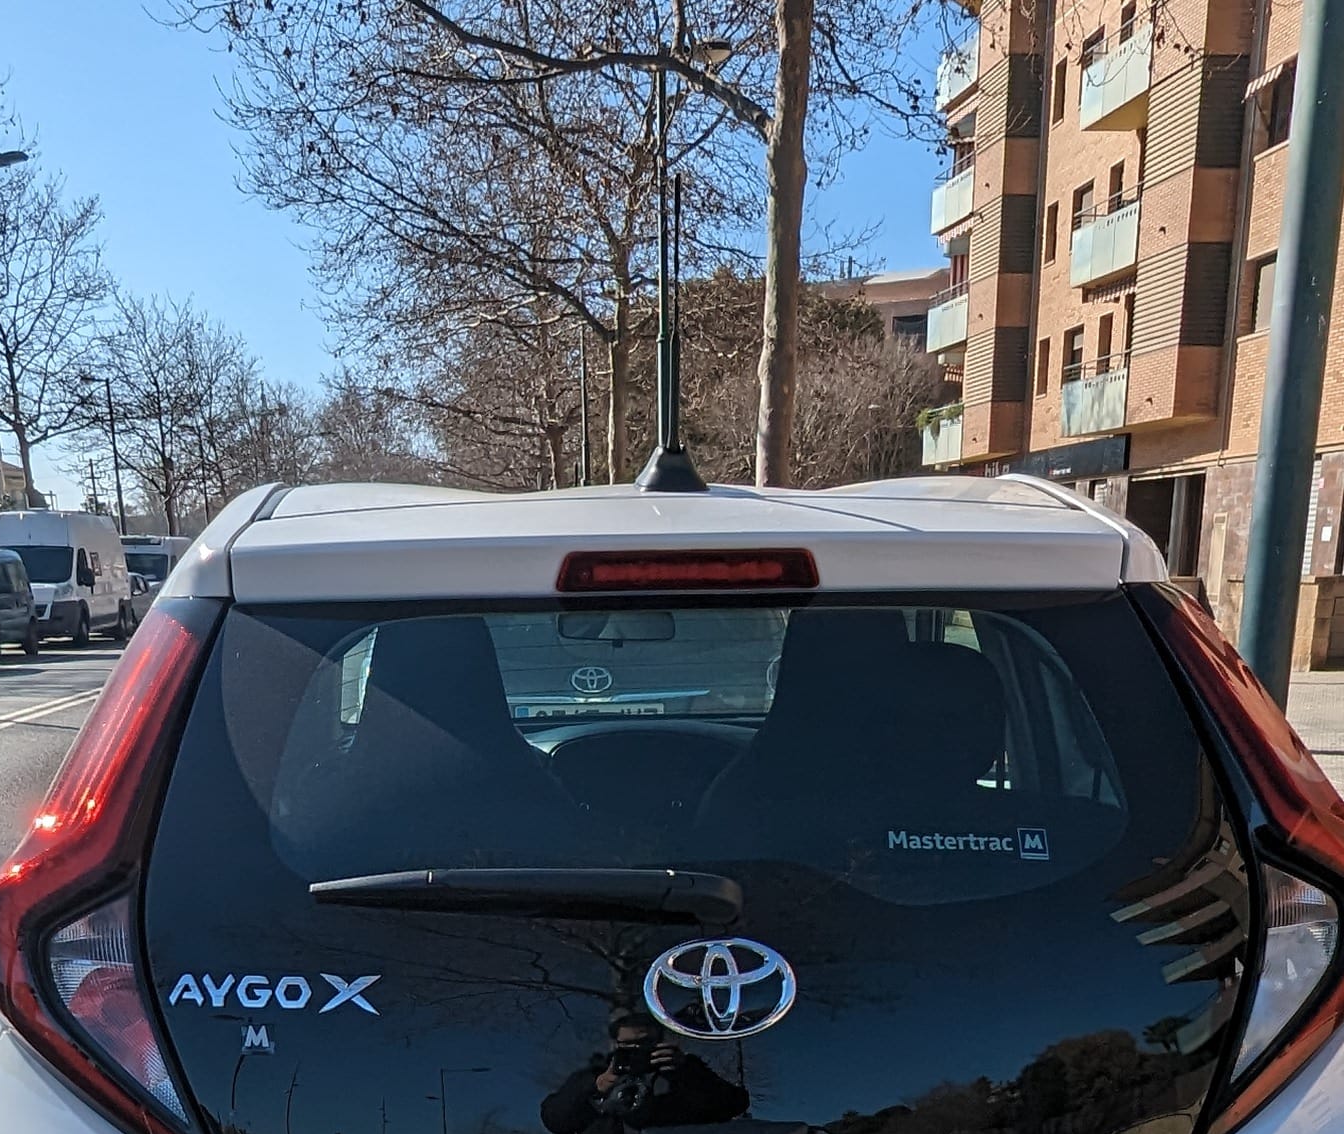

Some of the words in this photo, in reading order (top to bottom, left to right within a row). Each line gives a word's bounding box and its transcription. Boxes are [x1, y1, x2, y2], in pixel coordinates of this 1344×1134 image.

[887, 830, 1014, 852] Mastertrac
[168, 972, 313, 1010] AYGO
[318, 972, 383, 1017] X
[243, 1025, 271, 1049] M
